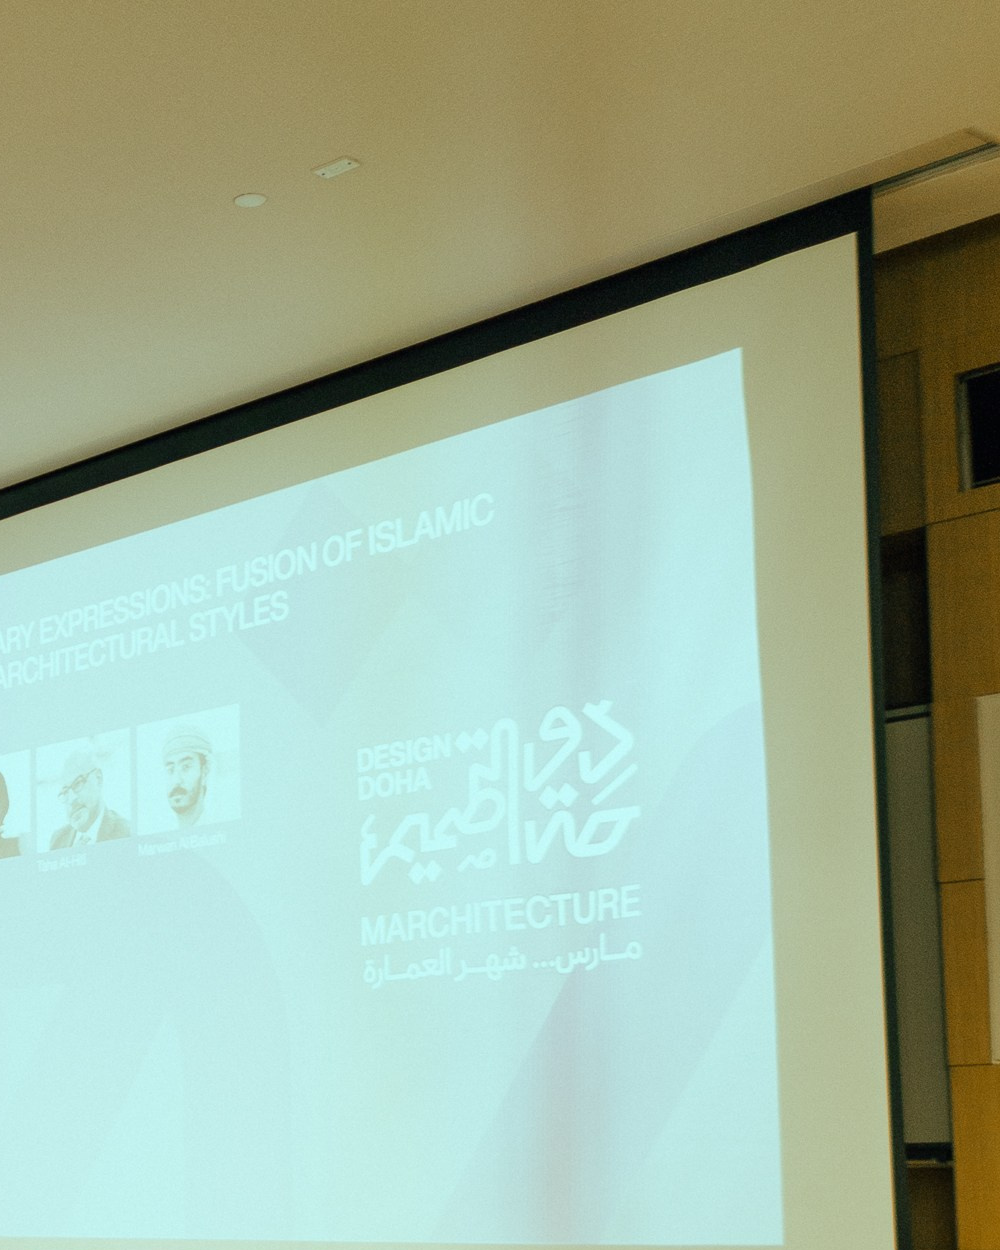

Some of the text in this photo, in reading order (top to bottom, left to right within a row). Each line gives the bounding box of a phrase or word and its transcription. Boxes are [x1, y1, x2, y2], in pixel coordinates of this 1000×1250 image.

[39, 573, 212, 645] EXPRESSIONS:
[216, 543, 318, 597] FUSION
[322, 529, 362, 568] OF
[369, 493, 496, 556] ISLAMIC
[189, 590, 290, 642] STYLES
[356, 731, 452, 773] DESIGN
[357, 766, 433, 801] DOHA
[360, 884, 642, 946] MARCHITECTURE
